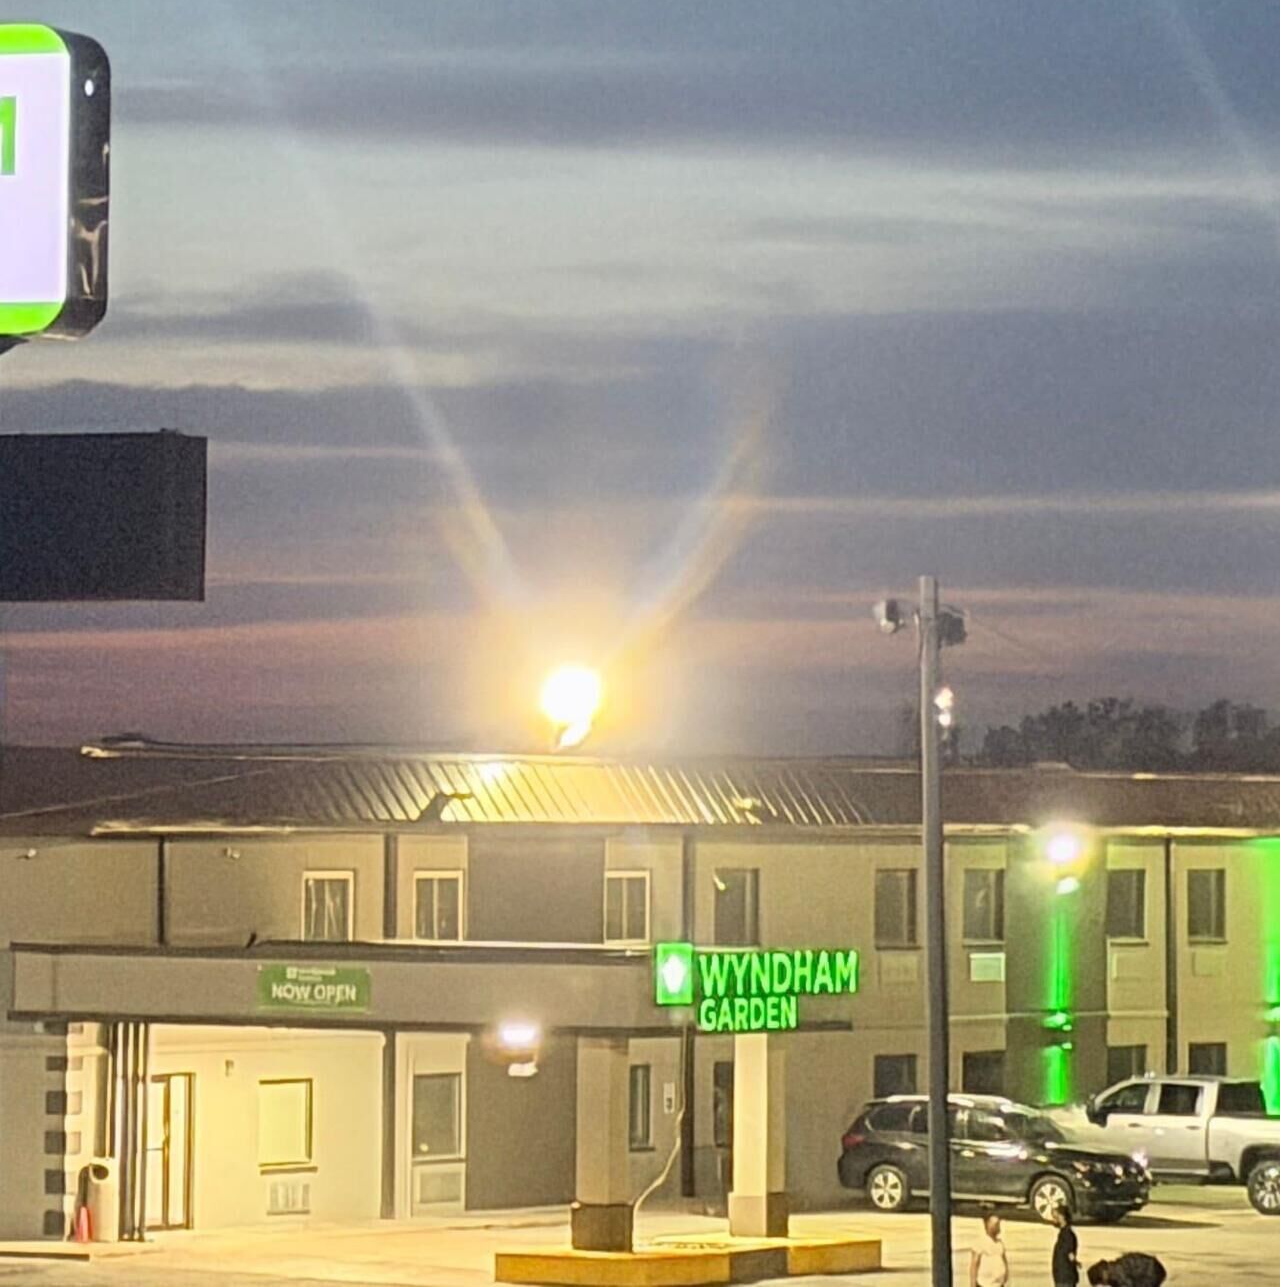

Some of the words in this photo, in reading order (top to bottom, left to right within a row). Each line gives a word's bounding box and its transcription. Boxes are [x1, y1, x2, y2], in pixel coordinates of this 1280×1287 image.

[698, 949, 858, 997] WYNDHAM
[271, 983, 311, 1001] NOW
[314, 984, 357, 1002] OPEN
[699, 995, 797, 1032] GARDEN
